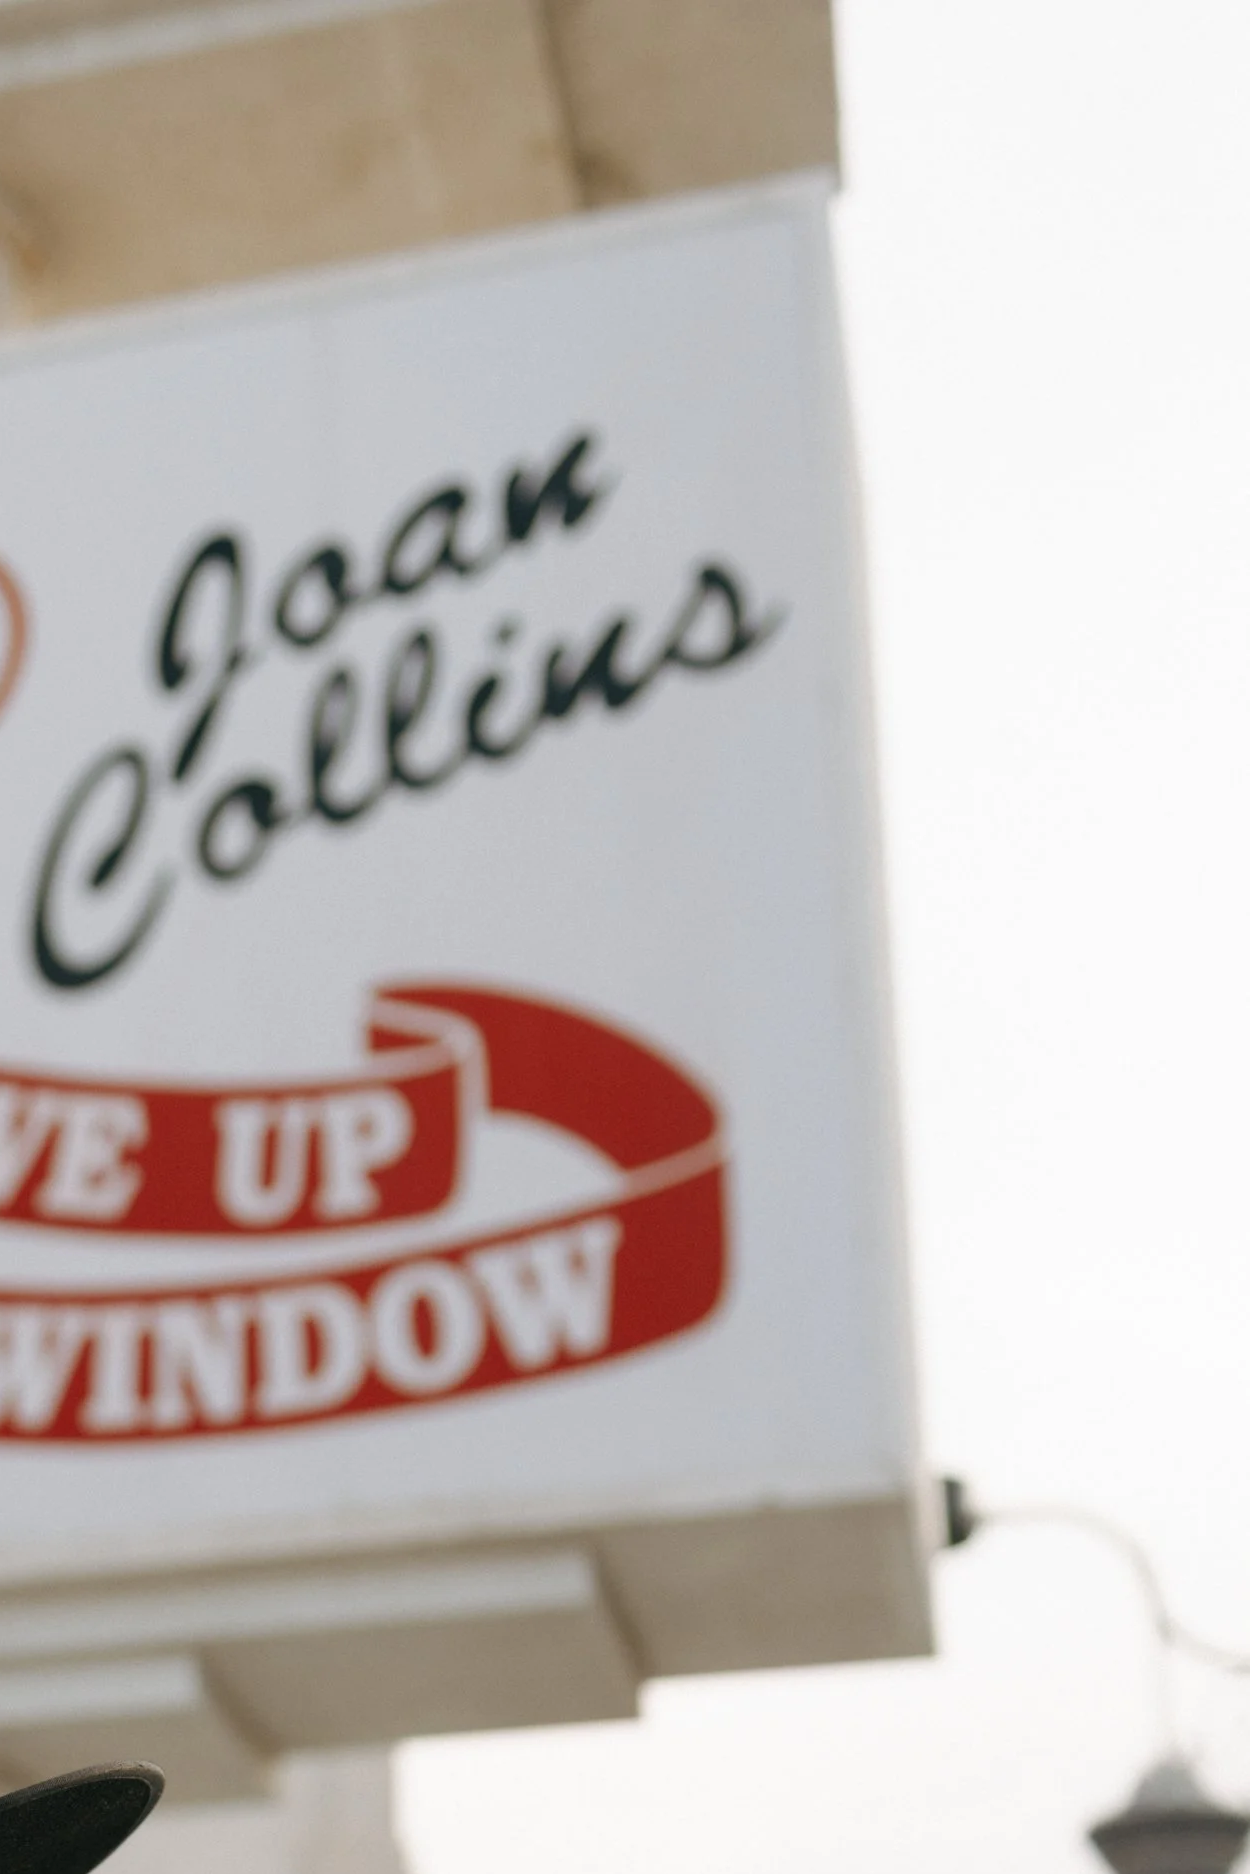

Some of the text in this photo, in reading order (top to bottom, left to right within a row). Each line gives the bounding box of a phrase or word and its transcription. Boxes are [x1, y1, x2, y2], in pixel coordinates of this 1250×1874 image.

[28, 558, 788, 990] Collins
[155, 426, 620, 785] Joan
[214, 1087, 414, 1227] UP
